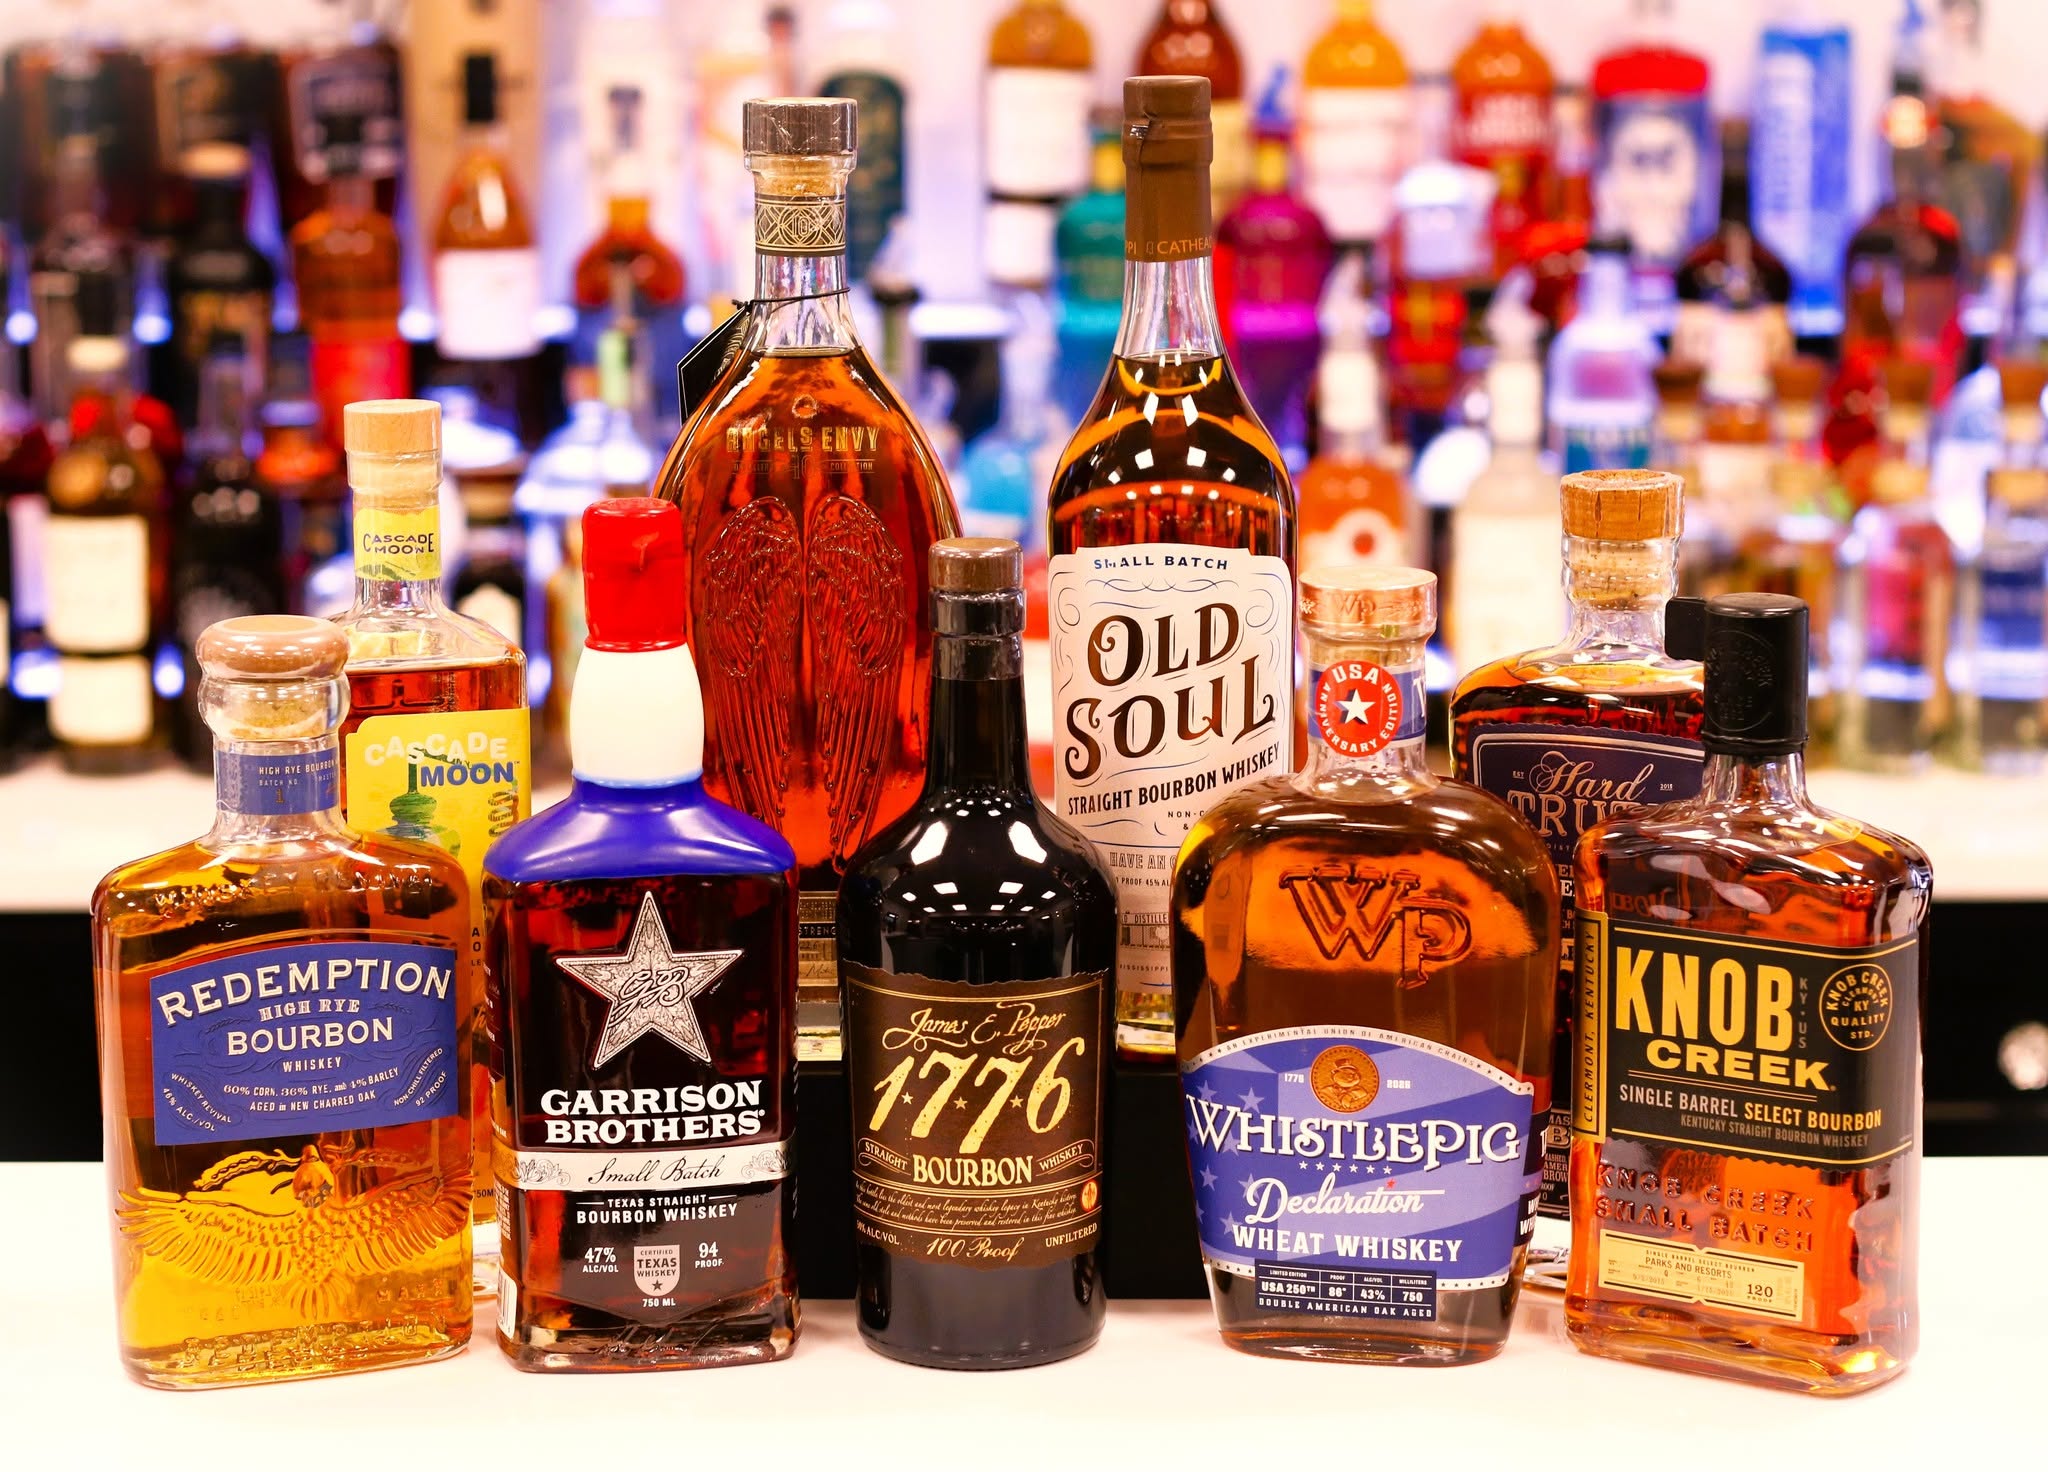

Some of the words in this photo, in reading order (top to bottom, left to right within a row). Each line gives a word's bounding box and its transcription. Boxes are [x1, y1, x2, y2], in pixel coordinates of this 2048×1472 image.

[821, 426, 879, 452] ENVY
[363, 533, 434, 552] CASCADE
[375, 545, 424, 554] MOON
[1164, 556, 1228, 570] BATCH
[1087, 602, 1239, 687] OLD
[1332, 664, 1380, 684] USA
[1065, 654, 1276, 780] SOUL
[1320, 681, 1377, 754] ANNIVERSARY
[1380, 684, 1398, 740] EDITION
[364, 732, 508, 766] CASCADE
[259, 766, 280, 775] HIGH
[285, 765, 301, 775] RYE
[1068, 790, 1132, 815] STRAIGHT
[1139, 770, 1217, 806] BOURBON
[1222, 741, 1280, 785] WHISKEY
[1529, 750, 1654, 800] Hard
[1507, 790, 1659, 837] TRU
[1109, 851, 1143, 869] HAVE
[1147, 854, 1166, 870] AN
[1121, 877, 1142, 886] PROOF
[1145, 879, 1160, 887] 45%
[1279, 864, 1472, 991] WP
[1583, 931, 1595, 1020] KENTUCKY
[157, 958, 452, 1026] REDEMPTION
[1615, 946, 1794, 1053] KNOB
[1826, 974, 1857, 1011] KNOB
[1861, 971, 1888, 1008] CREEK
[258, 1000, 311, 1022] HIGH
[319, 999, 360, 1014] RYE
[1854, 1000, 1870, 1012] KY
[882, 1008, 968, 1052] James
[996, 1001, 1066, 1056] Pepper
[1831, 1013, 1885, 1027] QUALITY
[227, 1016, 393, 1056] BOURBON
[1324, 1028, 1355, 1036] UNION
[1379, 1032, 1432, 1050] AMERICAN
[1850, 1030, 1874, 1039] STD.
[282, 1056, 343, 1073] WHISKEY
[394, 1072, 422, 1107] NON-CHILL
[419, 1047, 443, 1075] FILTERED
[1646, 1039, 1832, 1092] CREEK
[223, 1084, 250, 1096] 60%
[281, 1087, 308, 1097] 36%
[334, 1081, 347, 1091] and
[368, 1067, 399, 1085] BARLEY
[415, 1097, 425, 1107] 92
[425, 1070, 447, 1099] PROOF
[869, 1036, 1086, 1154] 1776
[171, 1073, 204, 1101] WHISKEY
[202, 1099, 232, 1123] REVIVAL
[249, 1101, 275, 1112] AGED
[279, 1102, 286, 1111] in
[291, 1101, 309, 1111] NEW
[314, 1094, 354, 1110] CHARRED
[358, 1090, 376, 1102] OAK
[540, 1080, 763, 1116] GARRISON
[1620, 1084, 1673, 1108] SINGLE
[1679, 1092, 1738, 1118] BARREL
[1744, 1102, 1802, 1126] SELECT
[1808, 1109, 1882, 1132] BOURBON
[544, 1110, 764, 1144] BROTHERS
[1186, 1094, 1520, 1172] WHISTLEPIG
[1681, 1114, 1727, 1132] KENTUCKY
[1728, 1123, 1772, 1138] STRAIGHT
[1775, 1130, 1820, 1145] BOURBON
[1822, 1134, 1869, 1148] WHISKEY
[587, 1157, 659, 1184] Small
[660, 1154, 725, 1181] Batch
[865, 1141, 908, 1171] STRAIGHT
[912, 1154, 1033, 1187] BOURBON
[1039, 1143, 1084, 1171] WHISKEY
[607, 1198, 644, 1208] TEXAS
[649, 1194, 707, 1207] STRAIGHT
[1245, 1172, 1445, 1224] Declaration
[1595, 1163, 1682, 1198] KNOB
[1703, 1184, 1814, 1219] CREEK
[576, 1209, 657, 1224] BOURBON
[663, 1203, 738, 1222] WHISKEY
[1595, 1196, 1692, 1231] SMALL
[1711, 1214, 1812, 1250] BATCH
[1045, 1222, 1098, 1248] UNFILTERED
[1232, 1224, 1324, 1255] WHEAT
[1334, 1234, 1463, 1262] WHISKEY
[584, 1246, 617, 1264] 47%
[698, 1241, 719, 1258] 94
[926, 1237, 966, 1258] 100
[966, 1236, 1025, 1262] Proof
[582, 1263, 619, 1274] ALC/VOL
[636, 1257, 677, 1269] TEXAS
[636, 1268, 677, 1278] WHISKEY
[1269, 1269, 1288, 1277] LIMITED
[1645, 1256, 1672, 1269] PARKS
[1675, 1262, 1692, 1272] AND
[1695, 1265, 1732, 1279] RESORTS
[1261, 1281, 1284, 1293] USA
[1360, 1289, 1386, 1300] 43%
[1402, 1291, 1423, 1302] 750
[1747, 1283, 1773, 1298] 120
[642, 1297, 660, 1308] 750
[662, 1297, 676, 1307] ML
[1259, 1297, 1300, 1309] DOUBLE
[1307, 1302, 1367, 1315] AMERICAN
[1374, 1306, 1396, 1316] OAK
[1403, 1308, 1432, 1318] AGED
